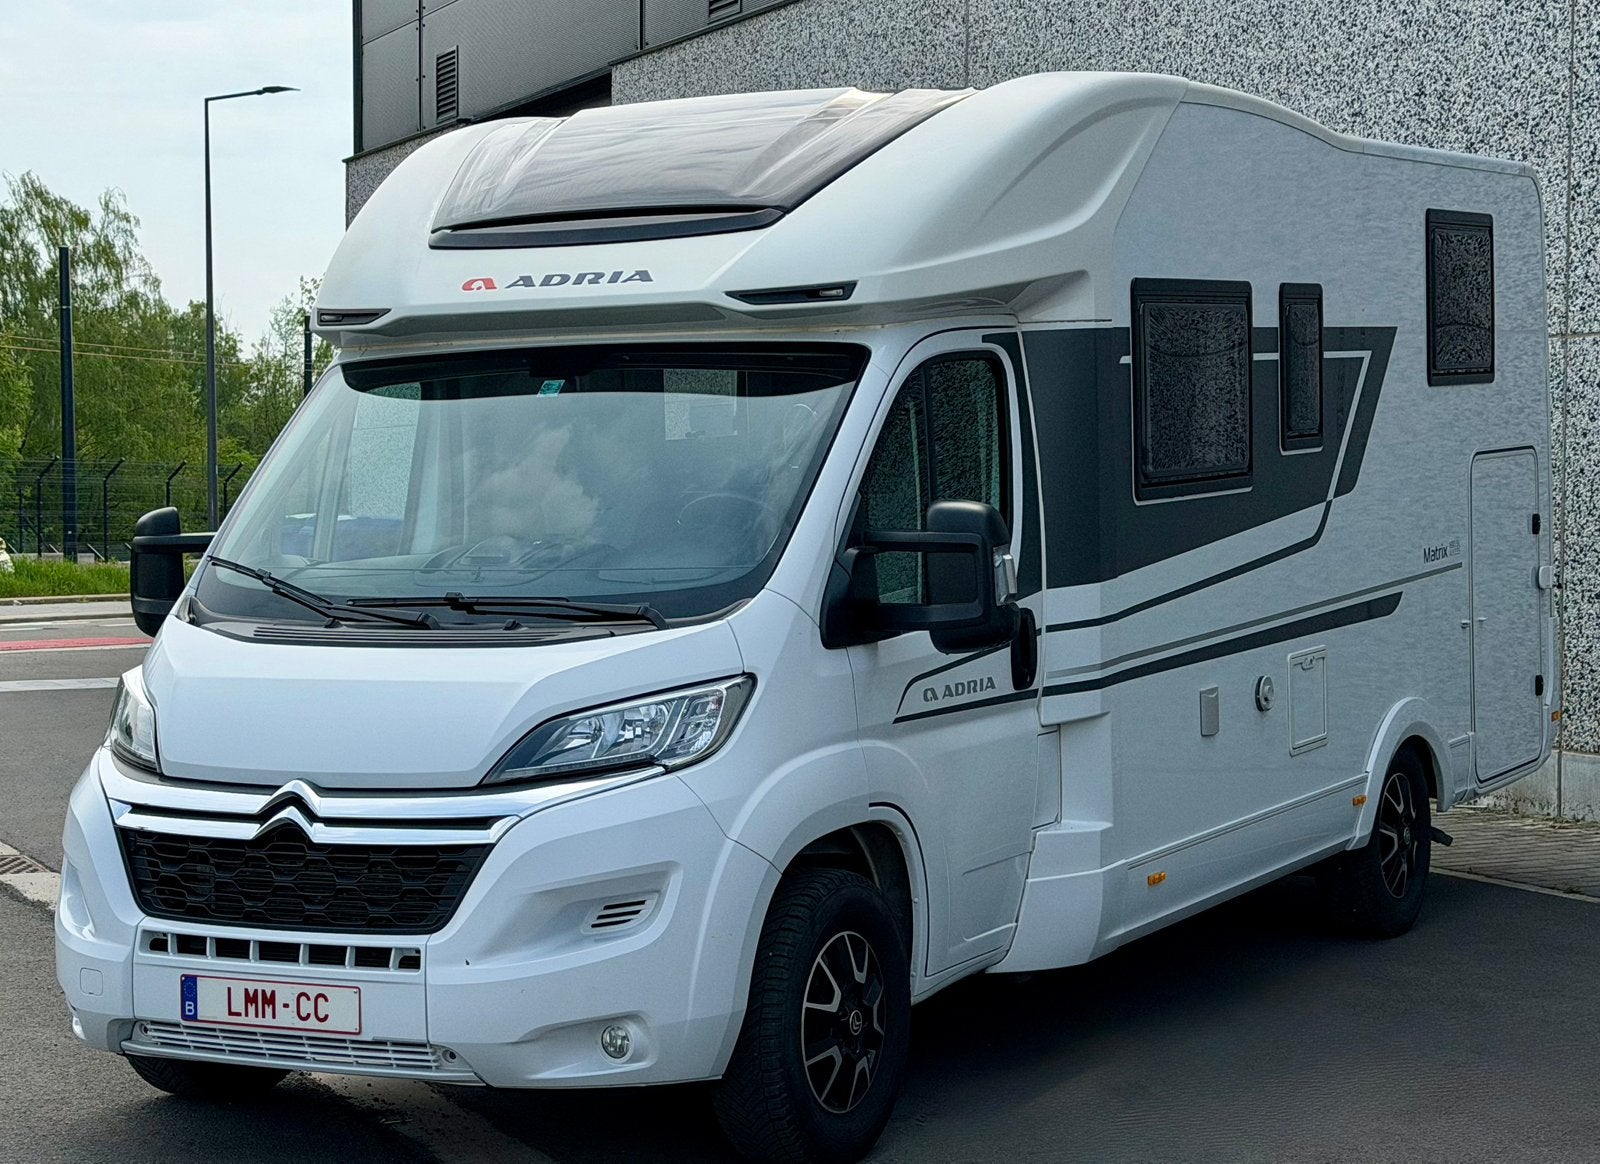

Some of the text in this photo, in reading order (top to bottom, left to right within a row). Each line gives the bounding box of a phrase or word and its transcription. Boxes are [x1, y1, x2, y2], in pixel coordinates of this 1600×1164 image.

[505, 270, 654, 289] ADRIA
[1423, 543, 1448, 564] Matrix
[942, 676, 996, 700] ADRIA
[185, 1001, 195, 1015] B
[227, 986, 329, 1023] LMM-CC
